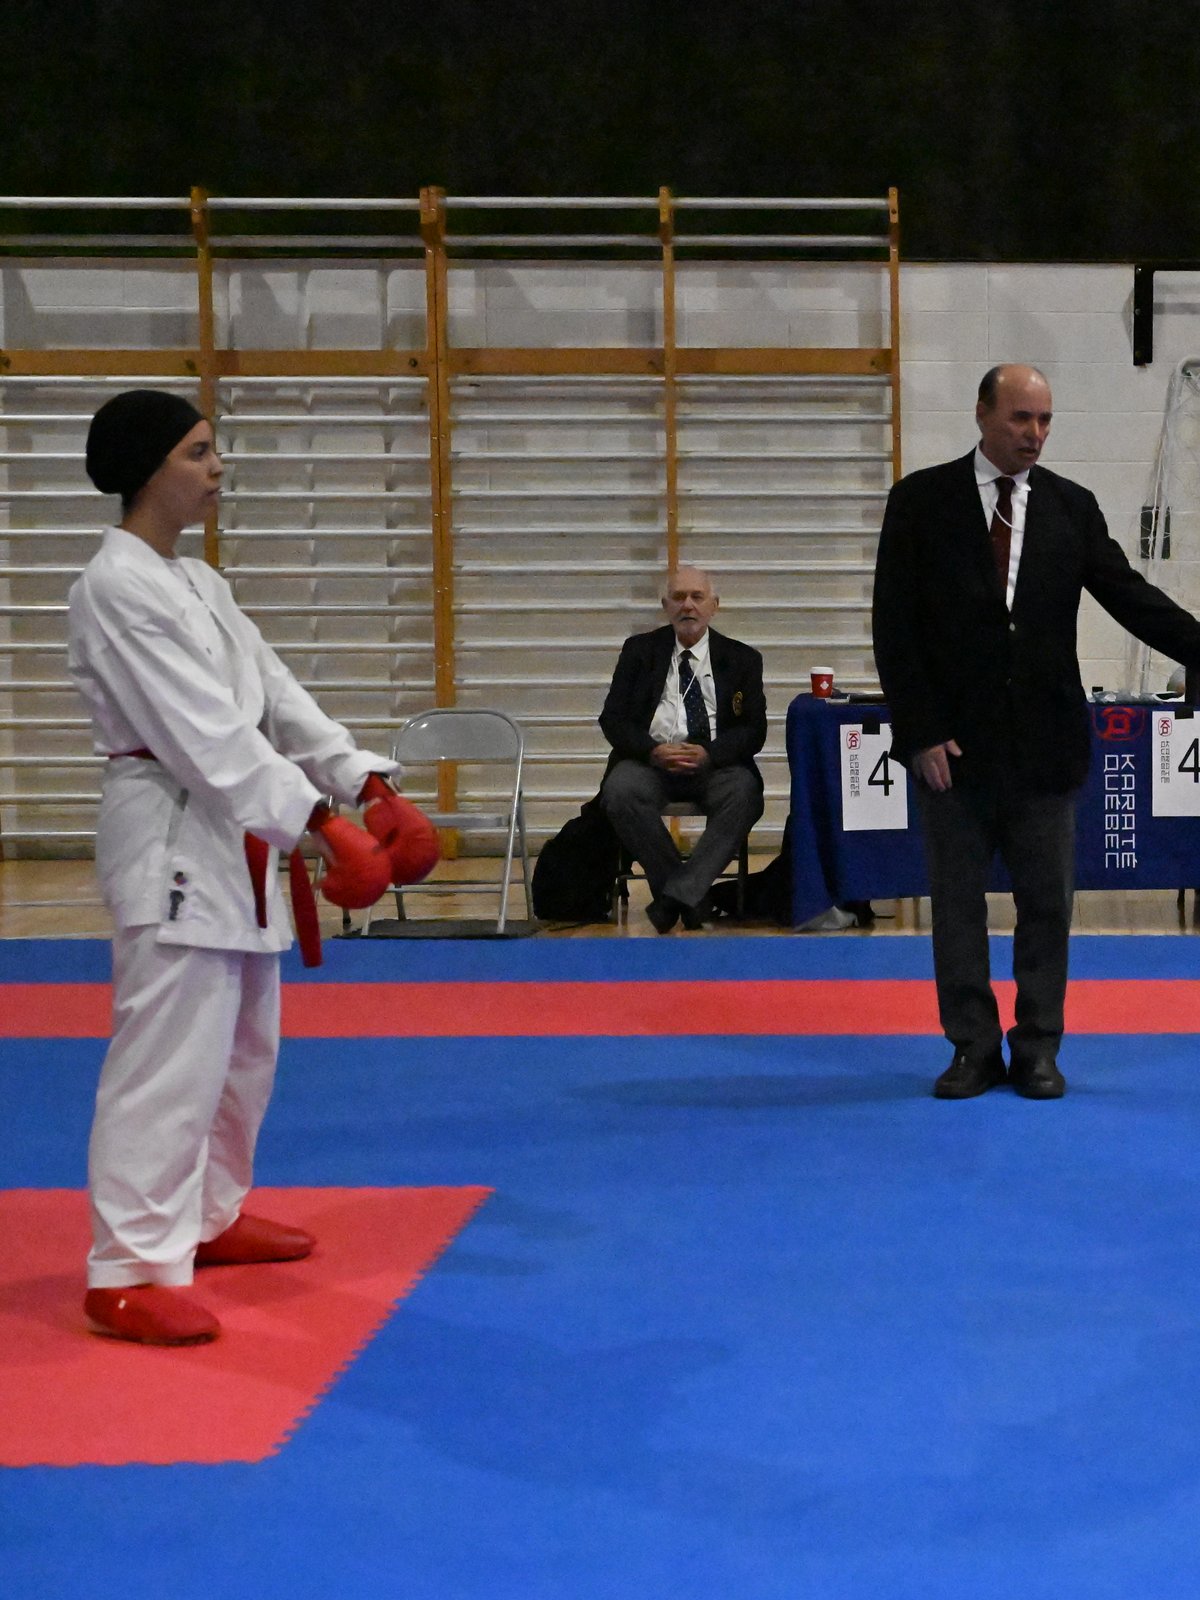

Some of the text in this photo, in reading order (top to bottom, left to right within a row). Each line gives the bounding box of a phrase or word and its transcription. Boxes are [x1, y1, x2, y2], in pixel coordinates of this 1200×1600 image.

[868, 751, 894, 796] 4
[1104, 754, 1121, 868] QUÉBEC
[1121, 754, 1138, 868] KARATÉ
